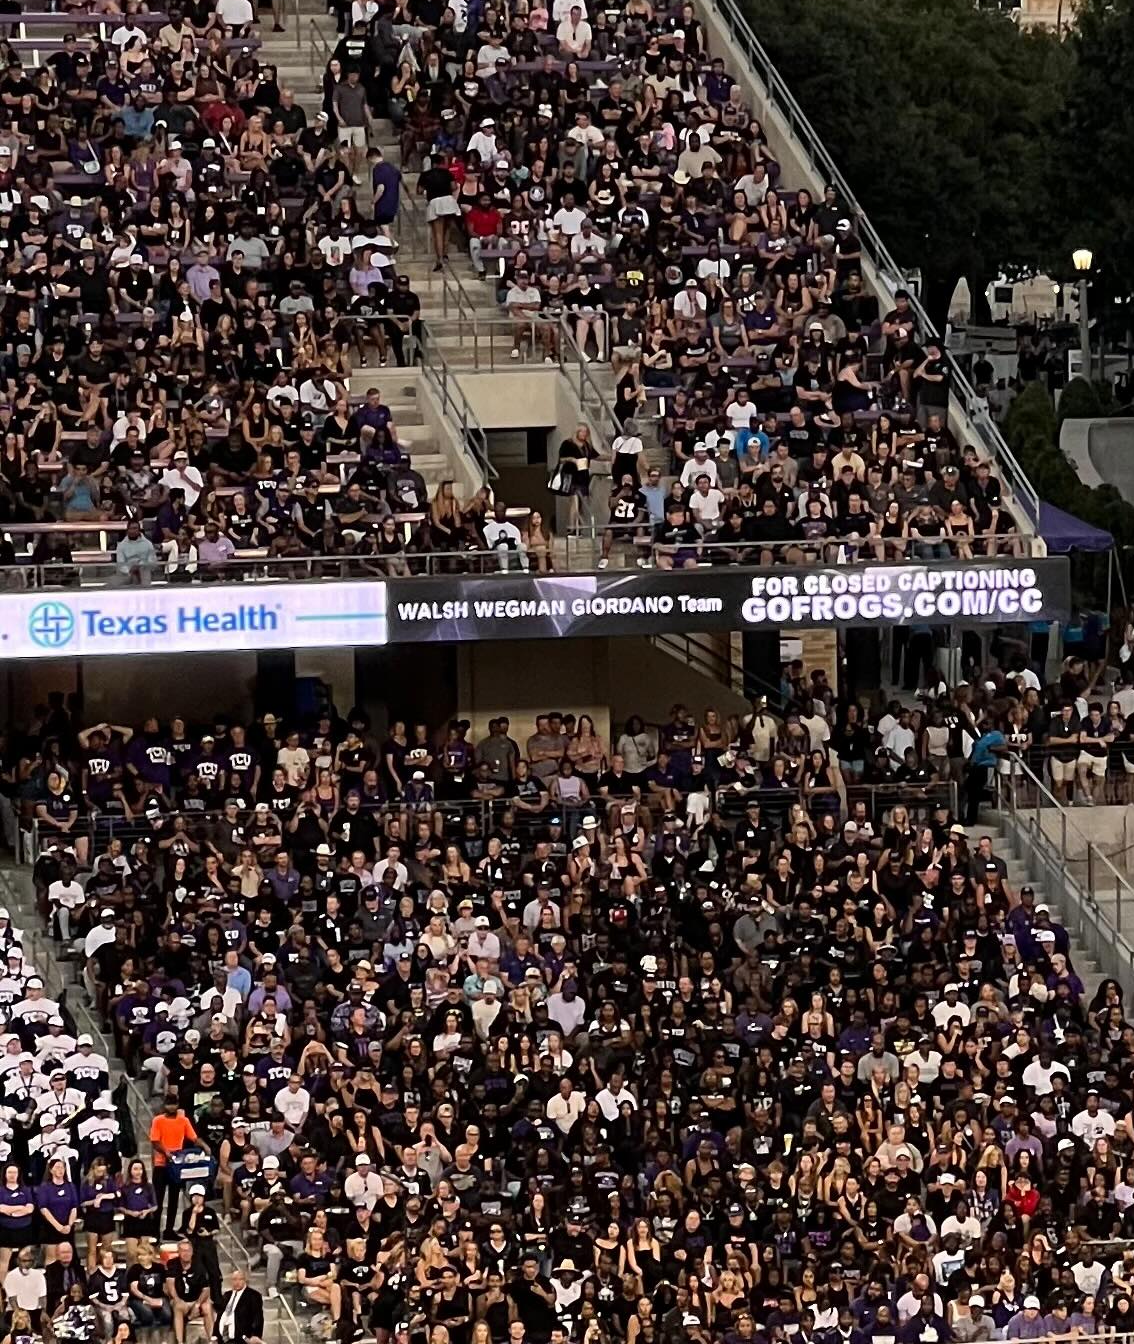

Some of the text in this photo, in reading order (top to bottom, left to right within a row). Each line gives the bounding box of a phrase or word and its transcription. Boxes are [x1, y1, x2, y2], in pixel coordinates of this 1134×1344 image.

[751, 567, 1036, 598] FOR CLOSED CAPTIONING
[397, 594, 723, 621] WALSH WEGMAN GIORDANO Team
[741, 587, 1043, 623] GOFROGS.COM/CC
[82, 604, 278, 637] Texas Health
[146, 746, 167, 763] TCU
[229, 752, 251, 769] TCU
[89, 758, 109, 775] TCU
[197, 762, 218, 779] TCU
[273, 797, 291, 810] TCU
[74, 1067, 99, 1079] TCU
[268, 1066, 292, 1079] TCU
[90, 1129, 114, 1144] TCU
[104, 1281, 118, 1302] 5
